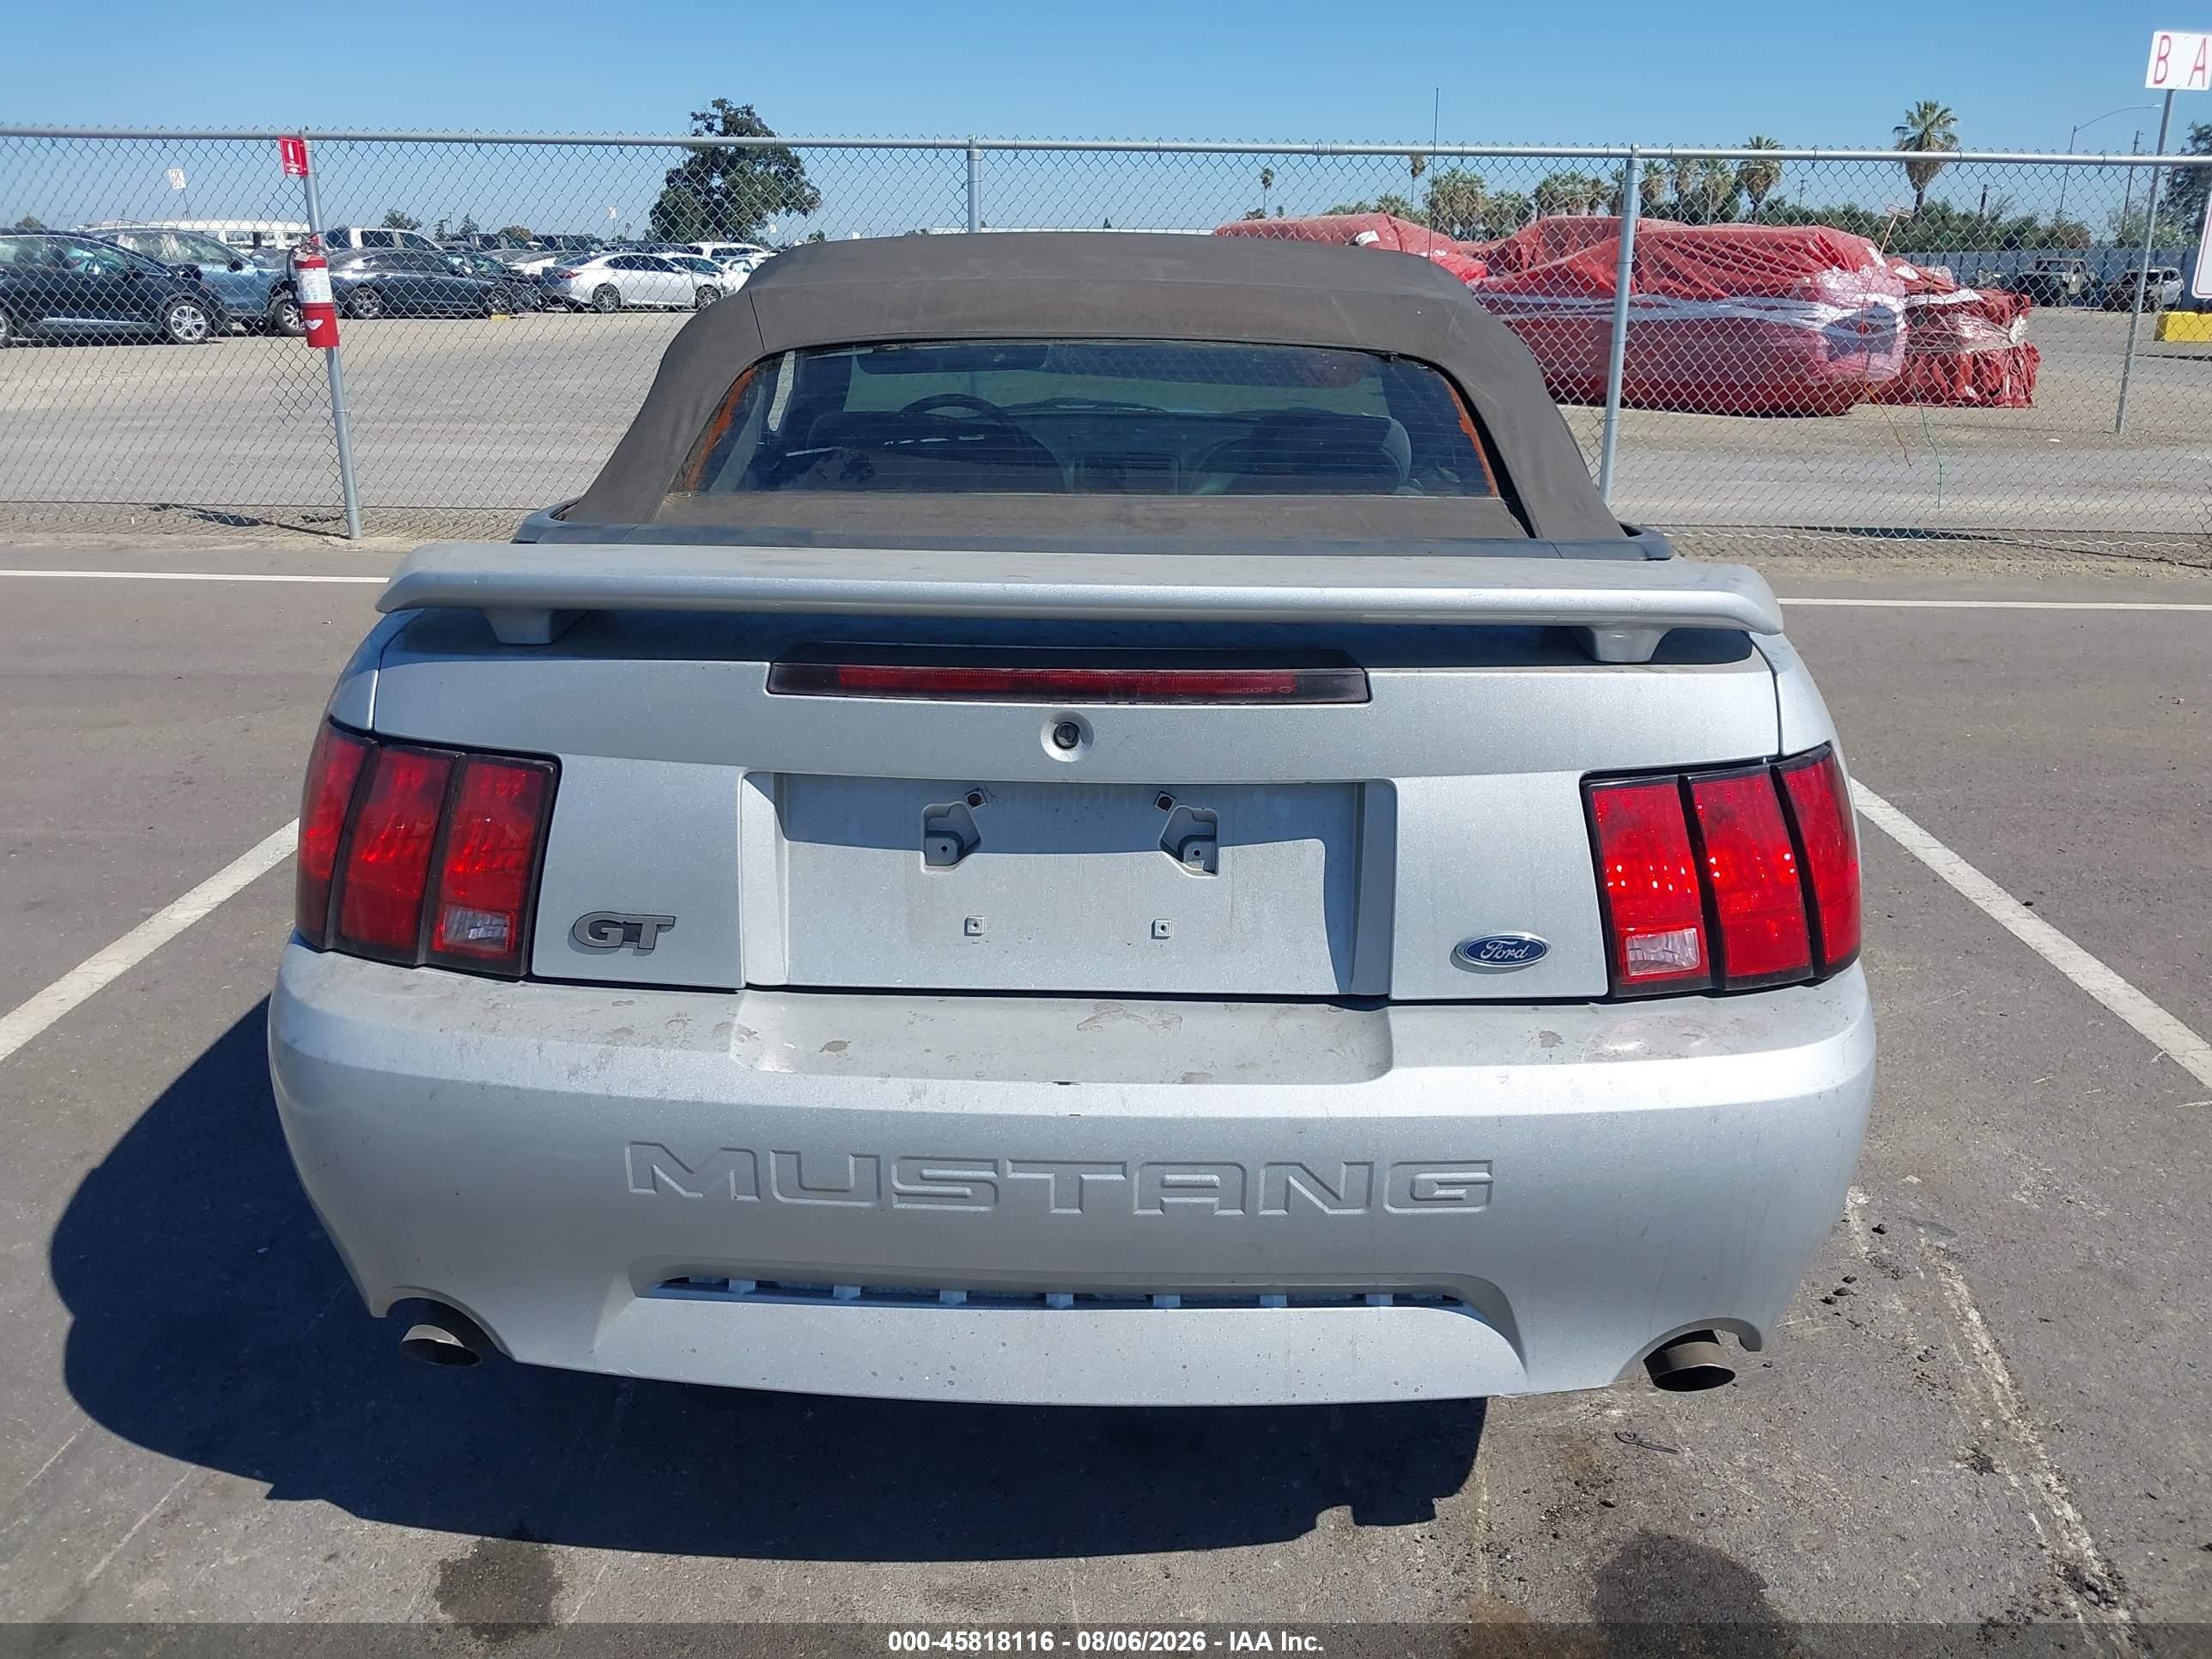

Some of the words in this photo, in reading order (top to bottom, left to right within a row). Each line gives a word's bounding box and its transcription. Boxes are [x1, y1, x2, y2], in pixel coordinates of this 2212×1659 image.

[2153, 35, 2172, 84] B
[2187, 37, 2207, 87] A
[573, 910, 676, 950] GT
[1480, 940, 1530, 959] Ford
[625, 1141, 1493, 1216] MUSTANG
